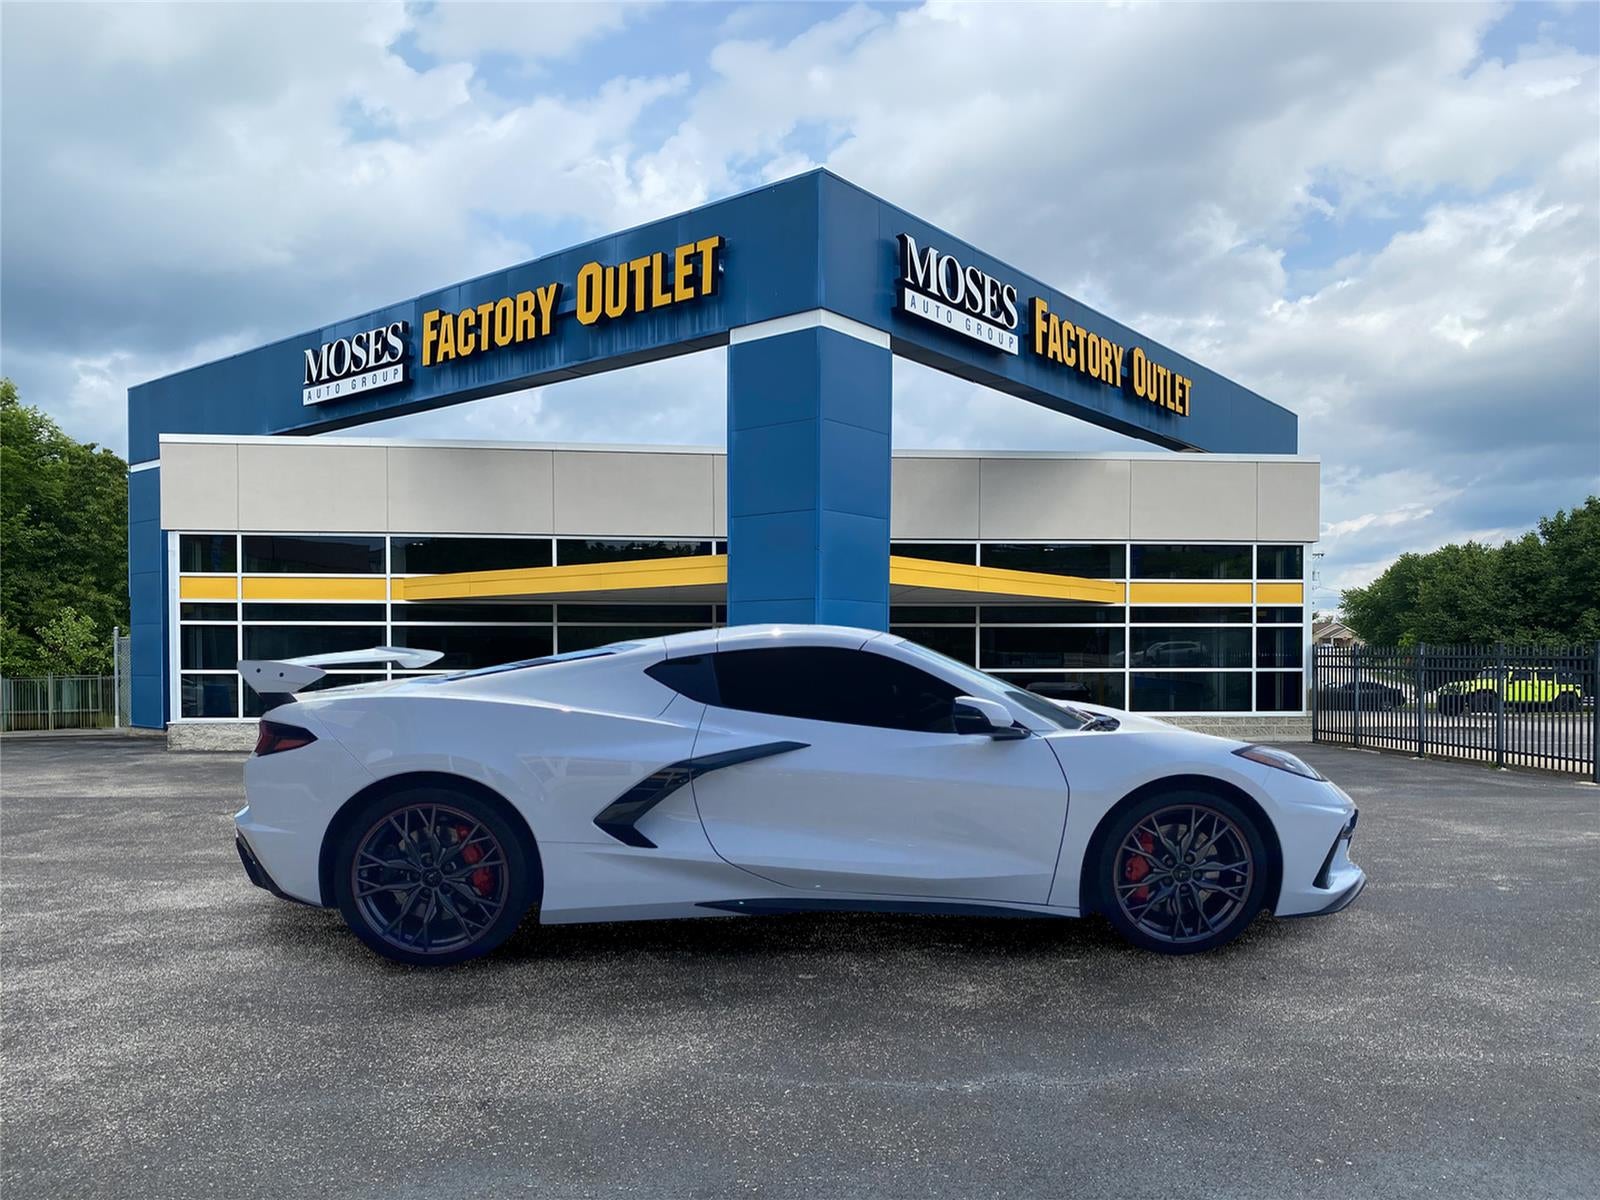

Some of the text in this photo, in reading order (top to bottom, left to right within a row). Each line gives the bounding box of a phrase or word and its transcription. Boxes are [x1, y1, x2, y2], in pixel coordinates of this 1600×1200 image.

[422, 235, 721, 367] FACTORY OUTLET
[904, 233, 1019, 330] MOSES
[303, 321, 404, 385] MOSES
[909, 294, 1016, 350] AUTO GROUP
[1034, 296, 1193, 417] FACTORY OUTLET
[306, 368, 400, 402] AUTO GROUP
